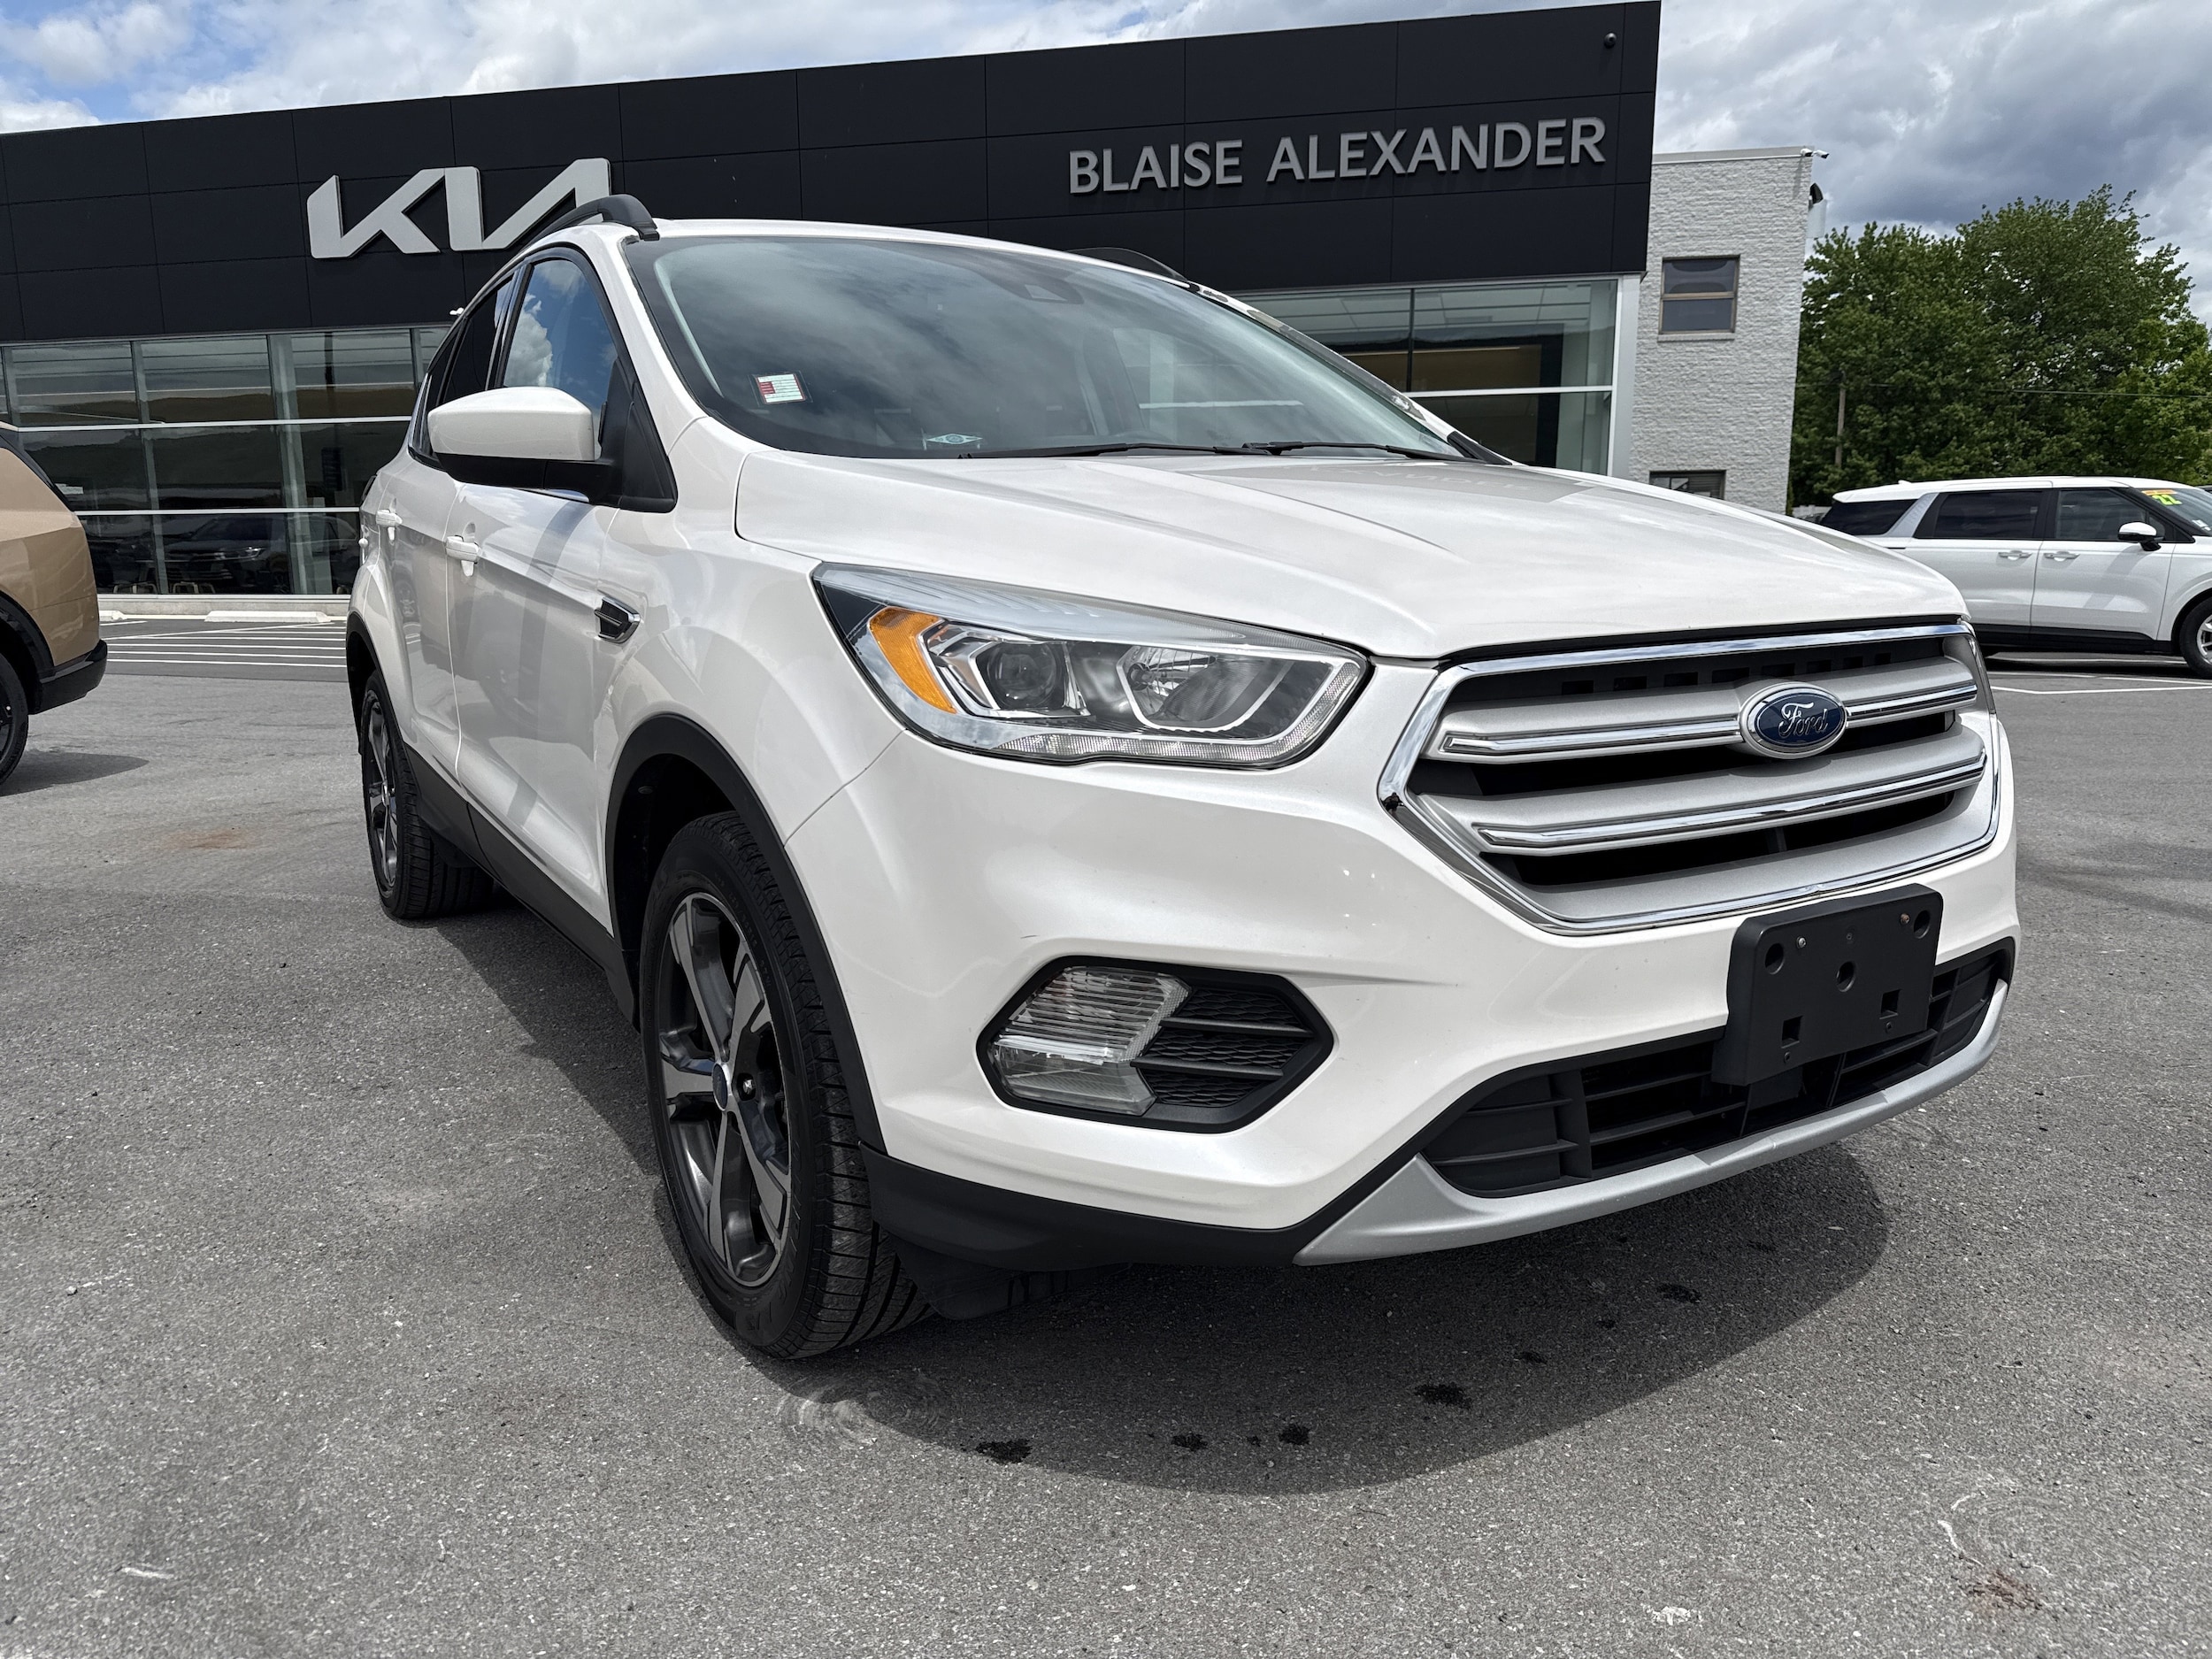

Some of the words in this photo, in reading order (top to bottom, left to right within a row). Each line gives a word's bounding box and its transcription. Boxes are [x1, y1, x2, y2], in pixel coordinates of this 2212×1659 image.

[1069, 139, 1243, 194] BLAISE
[1266, 116, 1607, 182] ALEXANDER
[307, 157, 612, 259] KIA
[1777, 702, 1829, 740] Ford
